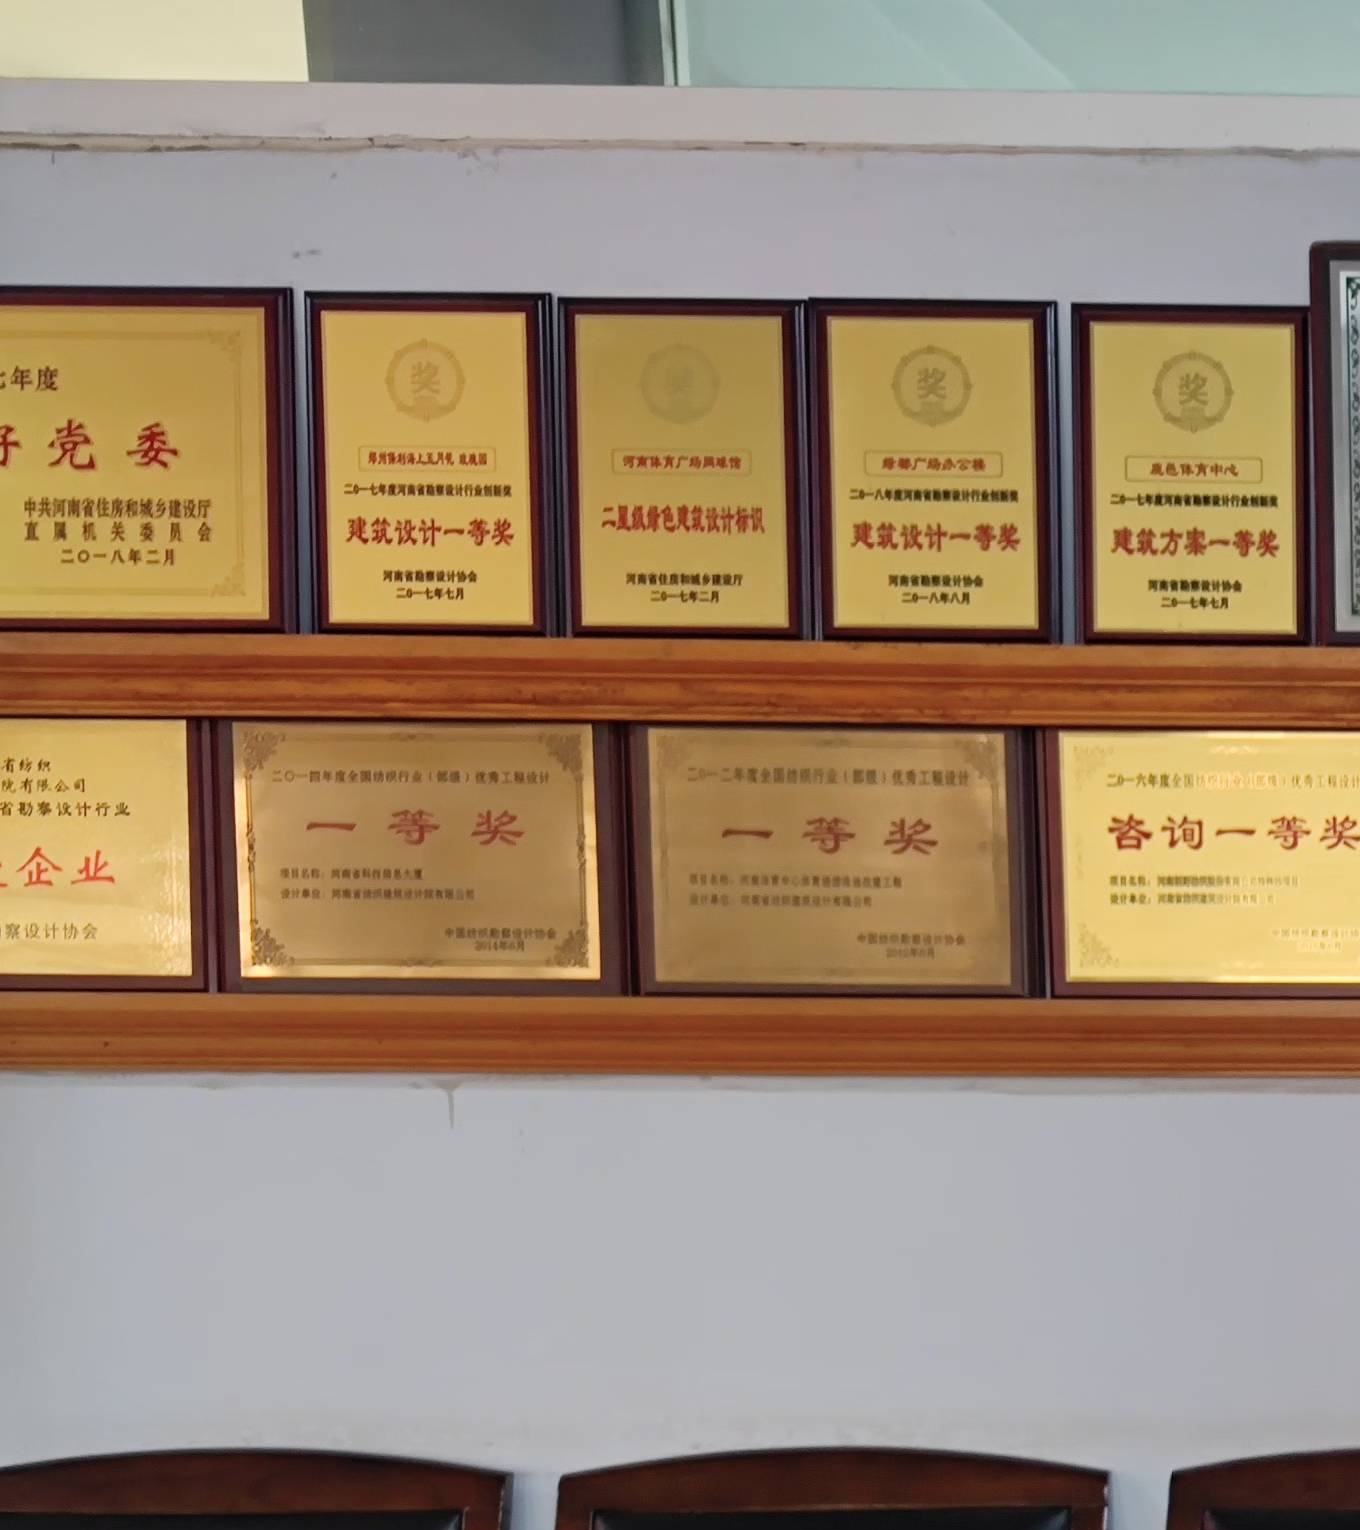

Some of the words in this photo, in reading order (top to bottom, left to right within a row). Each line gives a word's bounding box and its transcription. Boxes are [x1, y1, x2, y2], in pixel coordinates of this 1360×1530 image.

[917, 367, 947, 399] 奖
[1179, 371, 1209, 405] 奖
[24, 498, 211, 519] 中共河南省住房和城乡建设厅
[601, 504, 765, 534] 二星级绿色建筑设计标识
[24, 521, 212, 542] 直属机关委员会
[345, 517, 514, 548] 建筑设计一等奖
[850, 522, 1021, 552] 建筑设计一等奖
[1111, 527, 1279, 558] 建筑方案一等奖
[306, 809, 524, 848] 一等奖
[722, 817, 938, 856] 一等奖
[0, 846, 115, 887] 企业
[0, 922, 98, 941] 察设计协会
